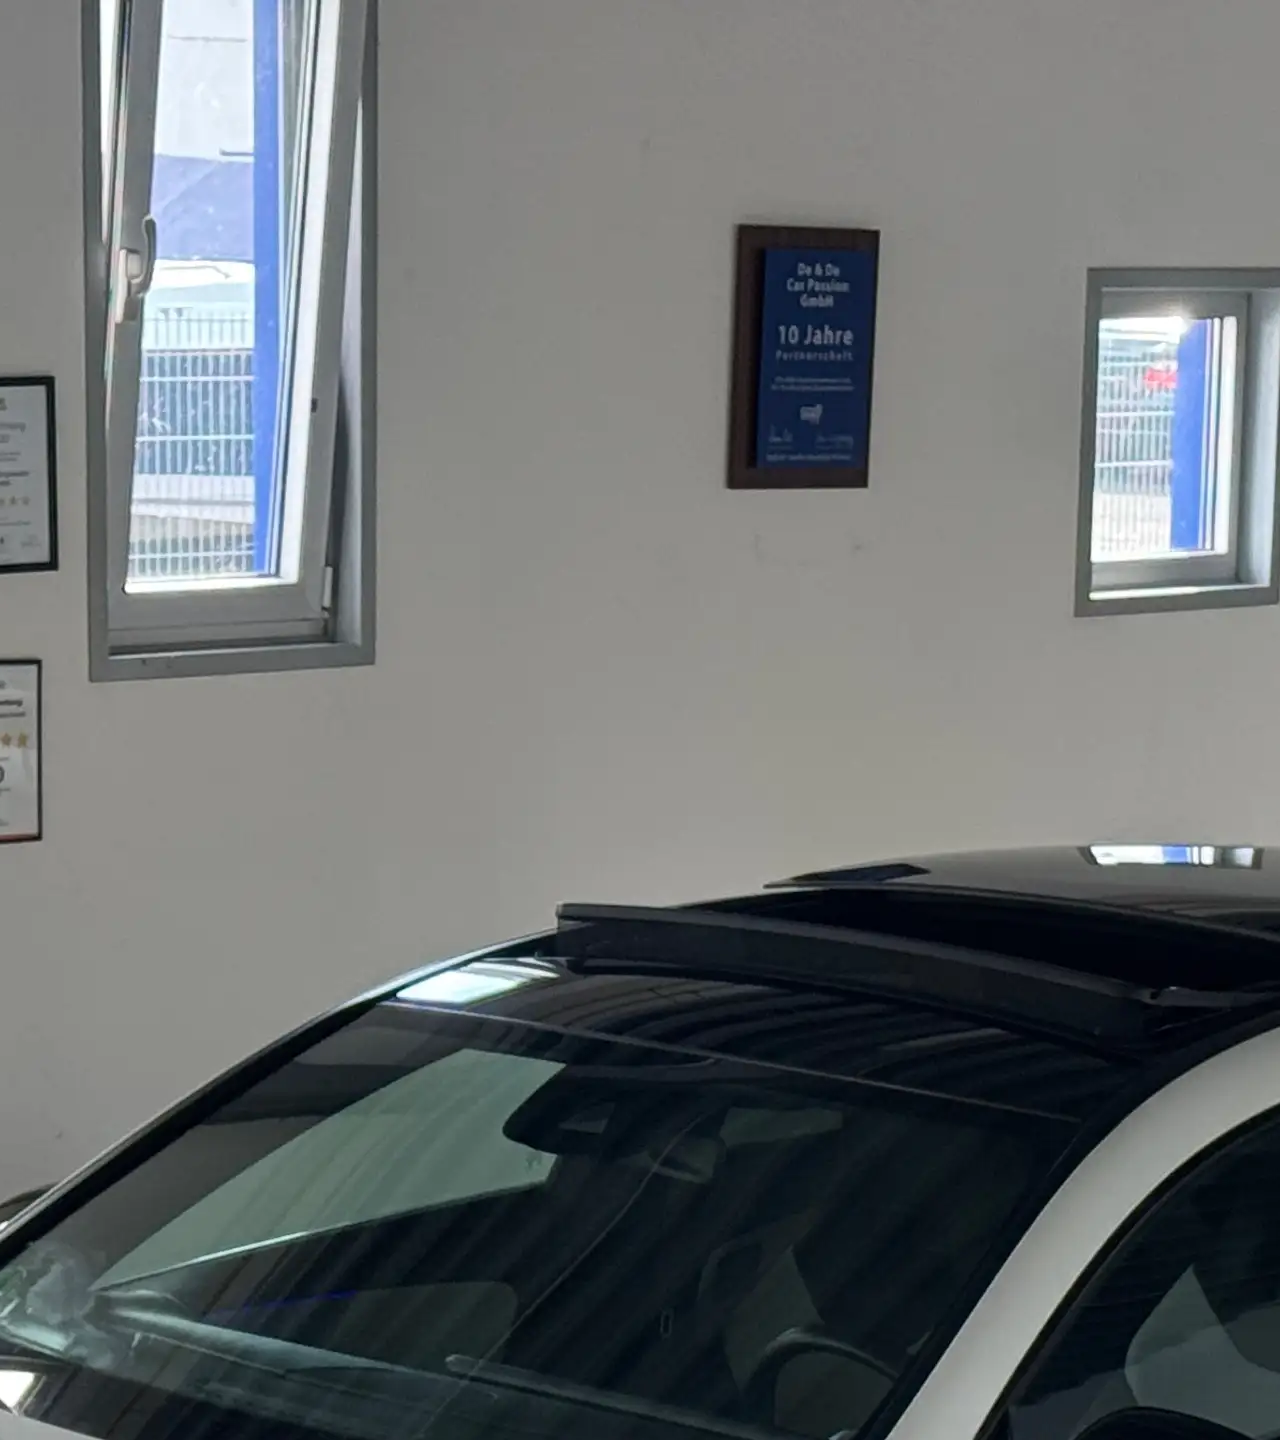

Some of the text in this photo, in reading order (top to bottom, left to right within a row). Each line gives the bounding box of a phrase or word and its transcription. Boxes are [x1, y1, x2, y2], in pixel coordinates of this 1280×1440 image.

[797, 262, 840, 276] De & De
[786, 278, 850, 292] Car Passion
[800, 293, 834, 308] GmbH
[777, 324, 854, 346] 10 Jahre
